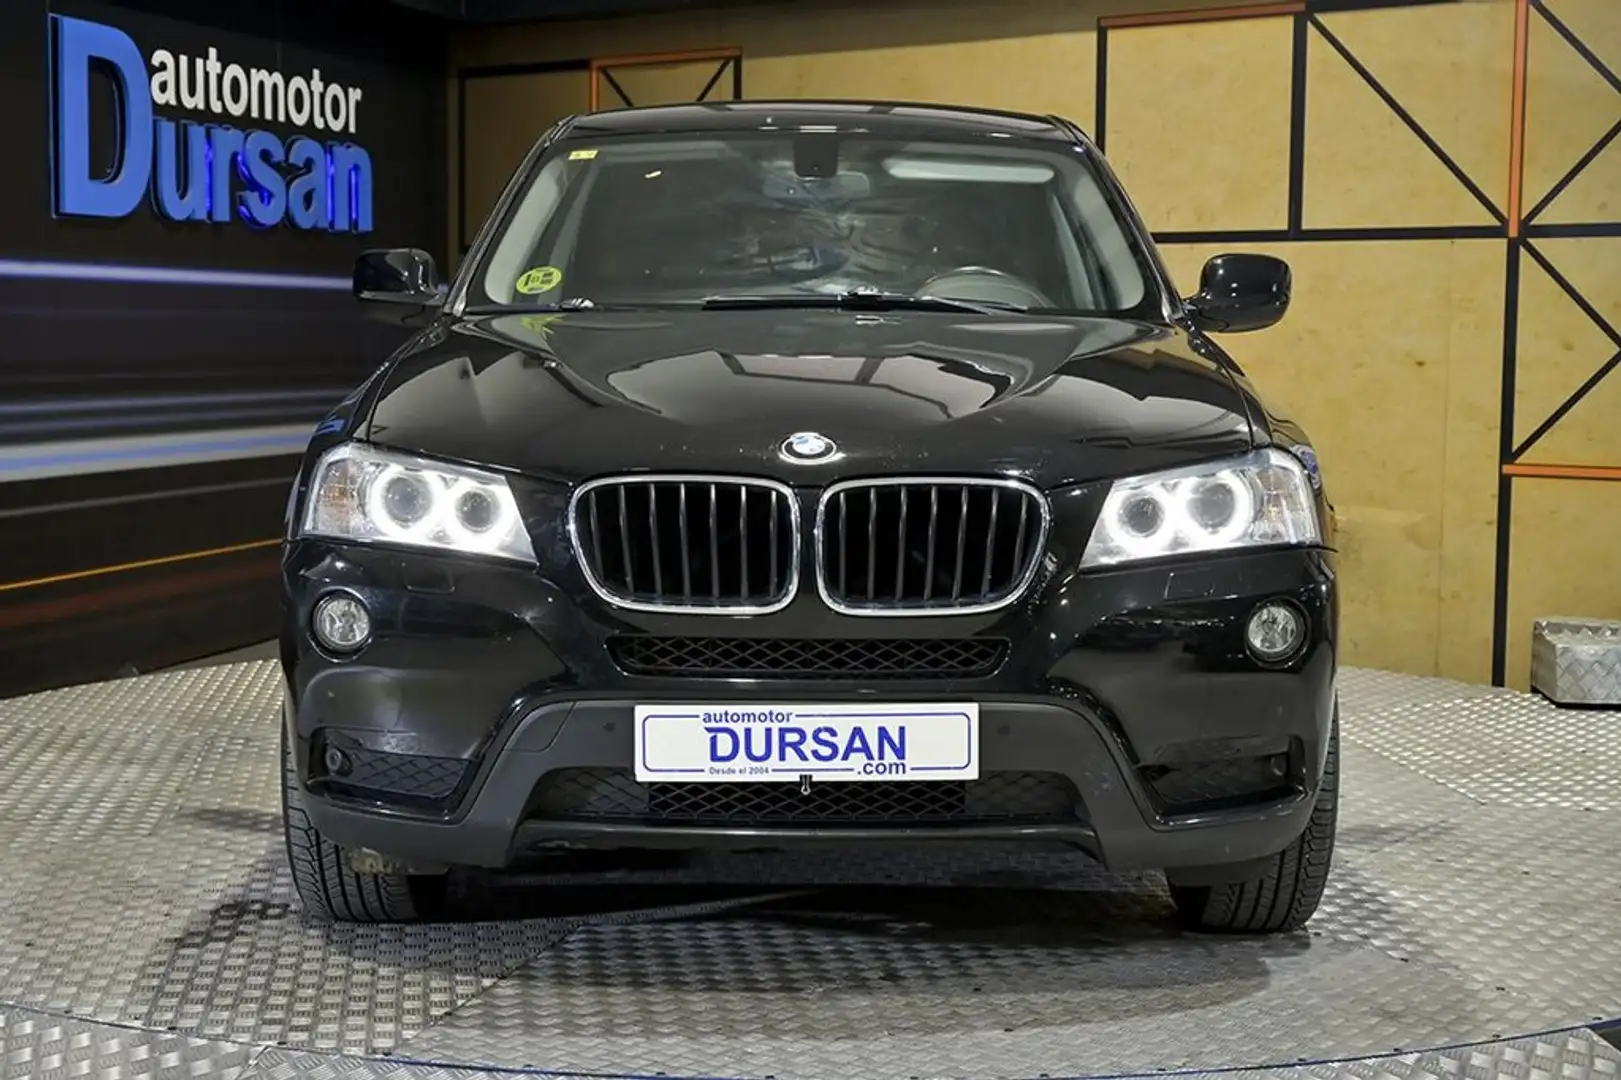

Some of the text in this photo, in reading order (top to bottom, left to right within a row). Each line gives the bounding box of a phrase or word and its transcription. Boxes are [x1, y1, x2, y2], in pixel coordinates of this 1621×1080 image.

[150, 46, 362, 133] automotor
[49, 12, 374, 233] Dursan
[702, 710, 793, 723] automotor
[704, 725, 906, 763] DURSAN
[856, 761, 906, 775] .com
